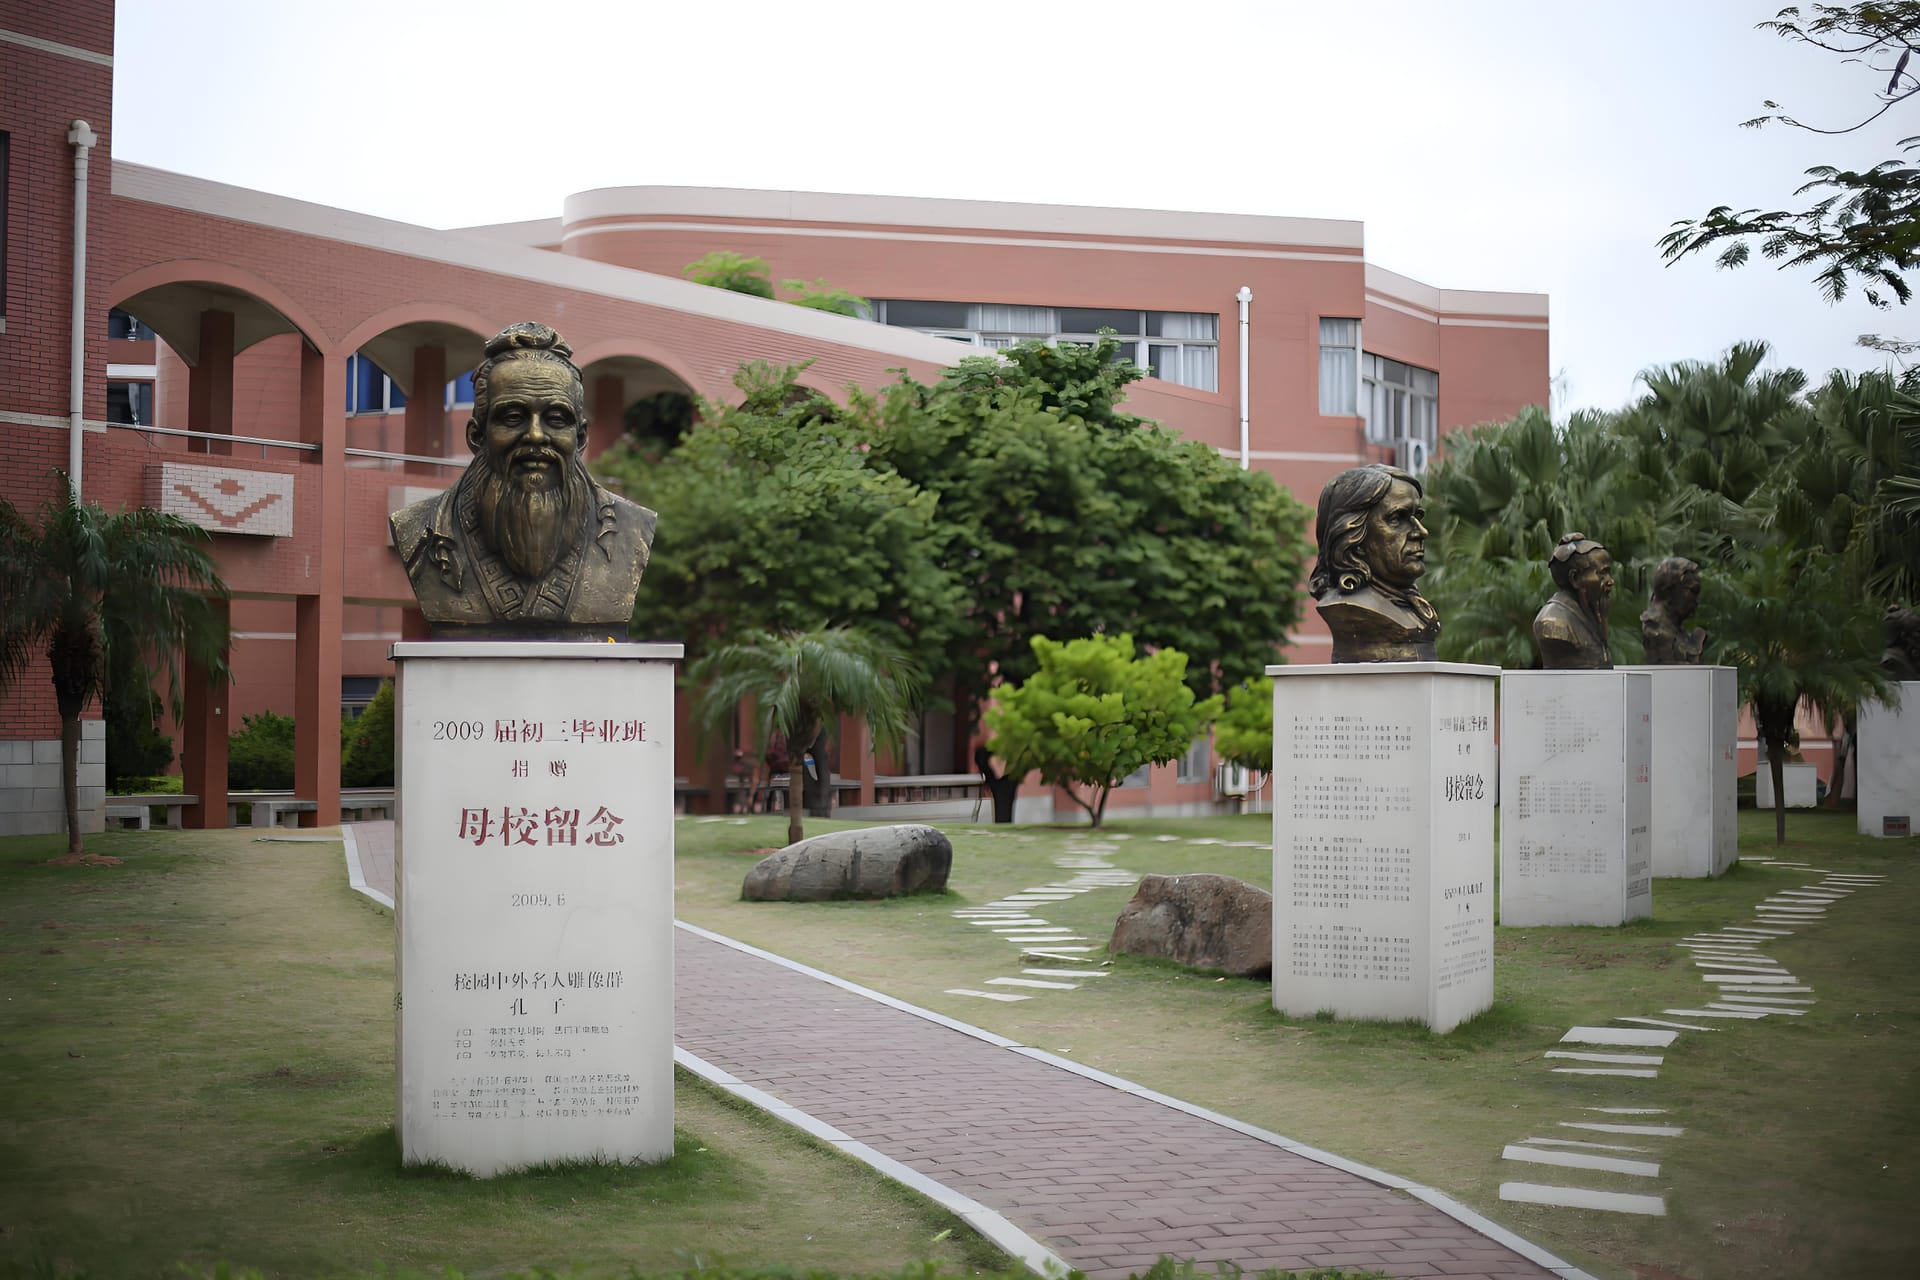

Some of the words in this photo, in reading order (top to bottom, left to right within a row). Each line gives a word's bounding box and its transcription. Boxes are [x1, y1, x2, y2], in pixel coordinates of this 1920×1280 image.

[433, 720, 484, 741] 2009
[494, 718, 647, 744] 届初三毕业班
[457, 806, 625, 847] 母校留念
[454, 970, 625, 991] 校园中外名人雕像群
